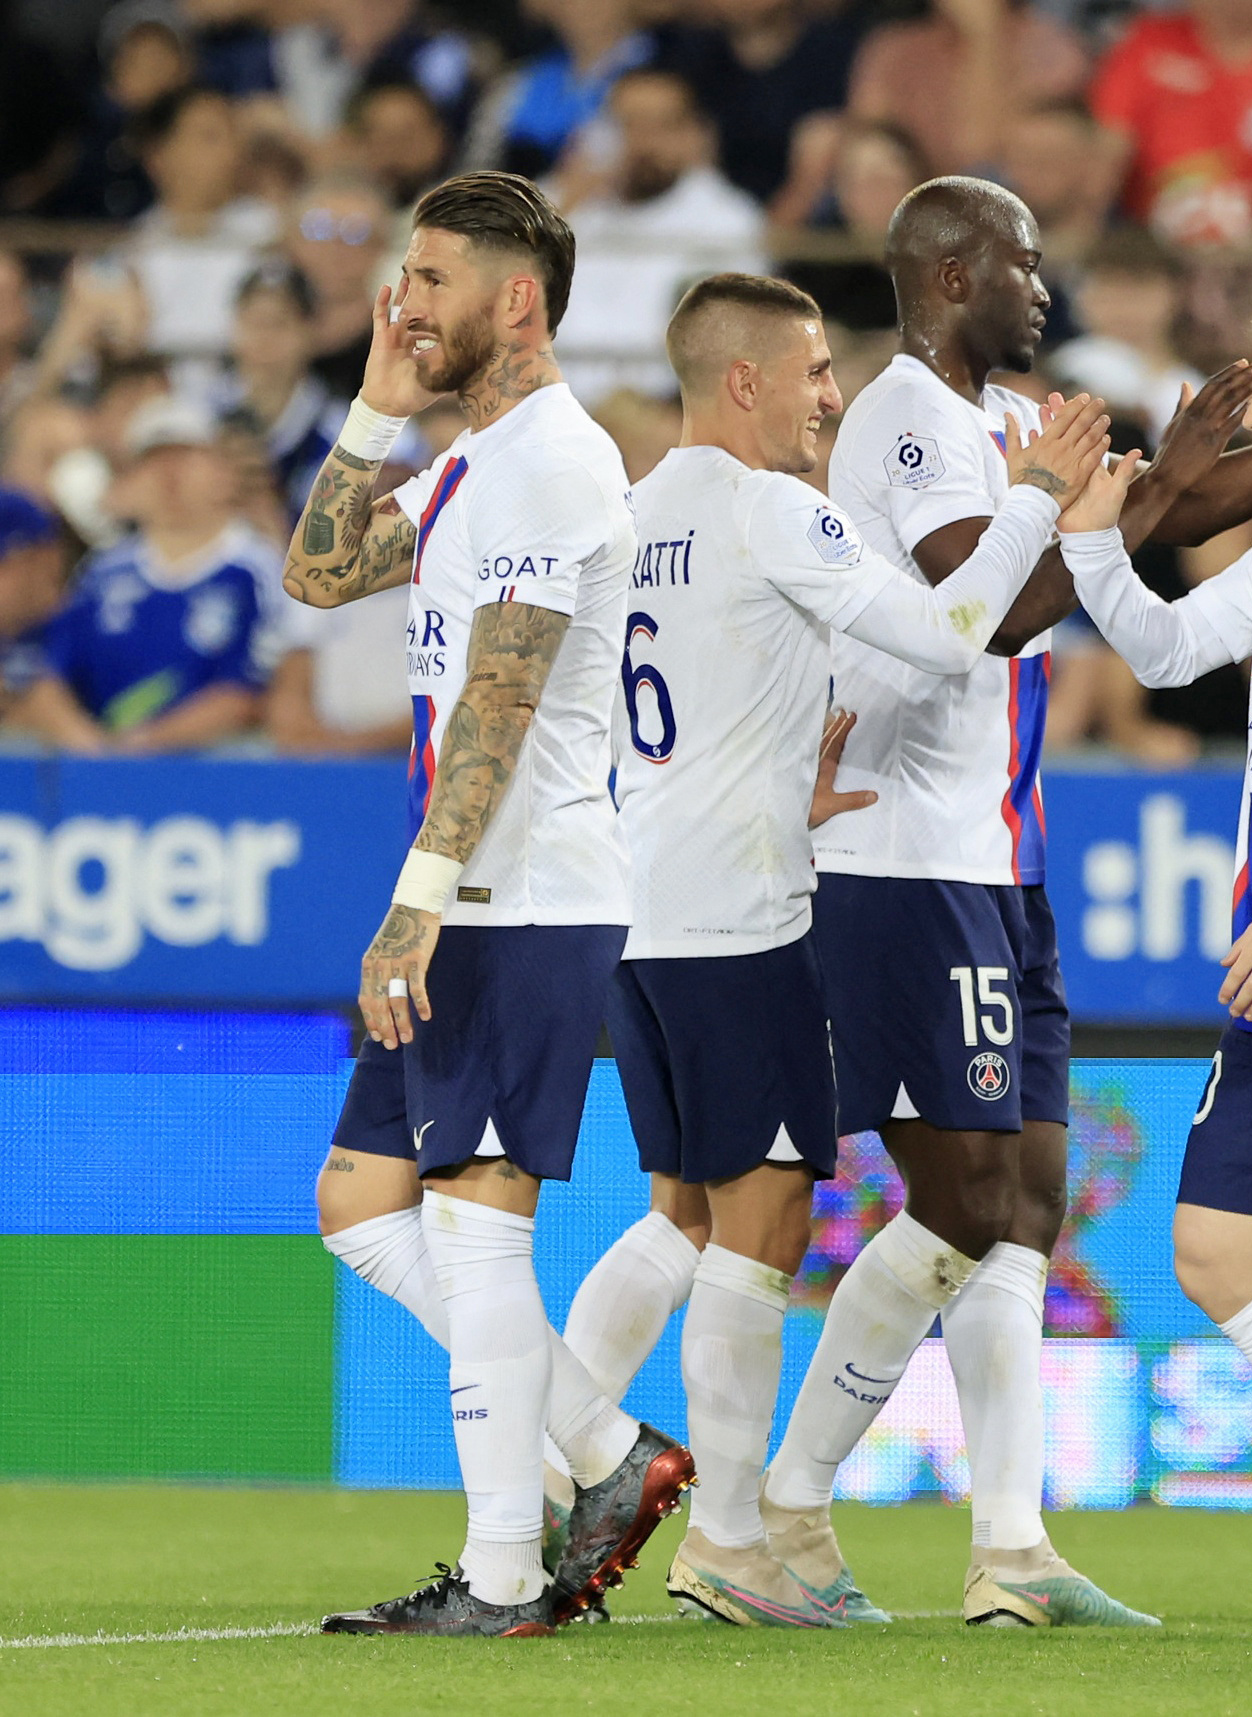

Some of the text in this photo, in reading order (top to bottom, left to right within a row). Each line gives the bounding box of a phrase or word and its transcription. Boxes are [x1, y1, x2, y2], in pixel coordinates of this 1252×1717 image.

[477, 556, 558, 581] GOAT
[621, 611, 677, 765] 6
[0, 812, 301, 971] ager
[949, 966, 1014, 1046] 15
[974, 1054, 1003, 1068] PARIS
[452, 1409, 488, 1421] RIS
